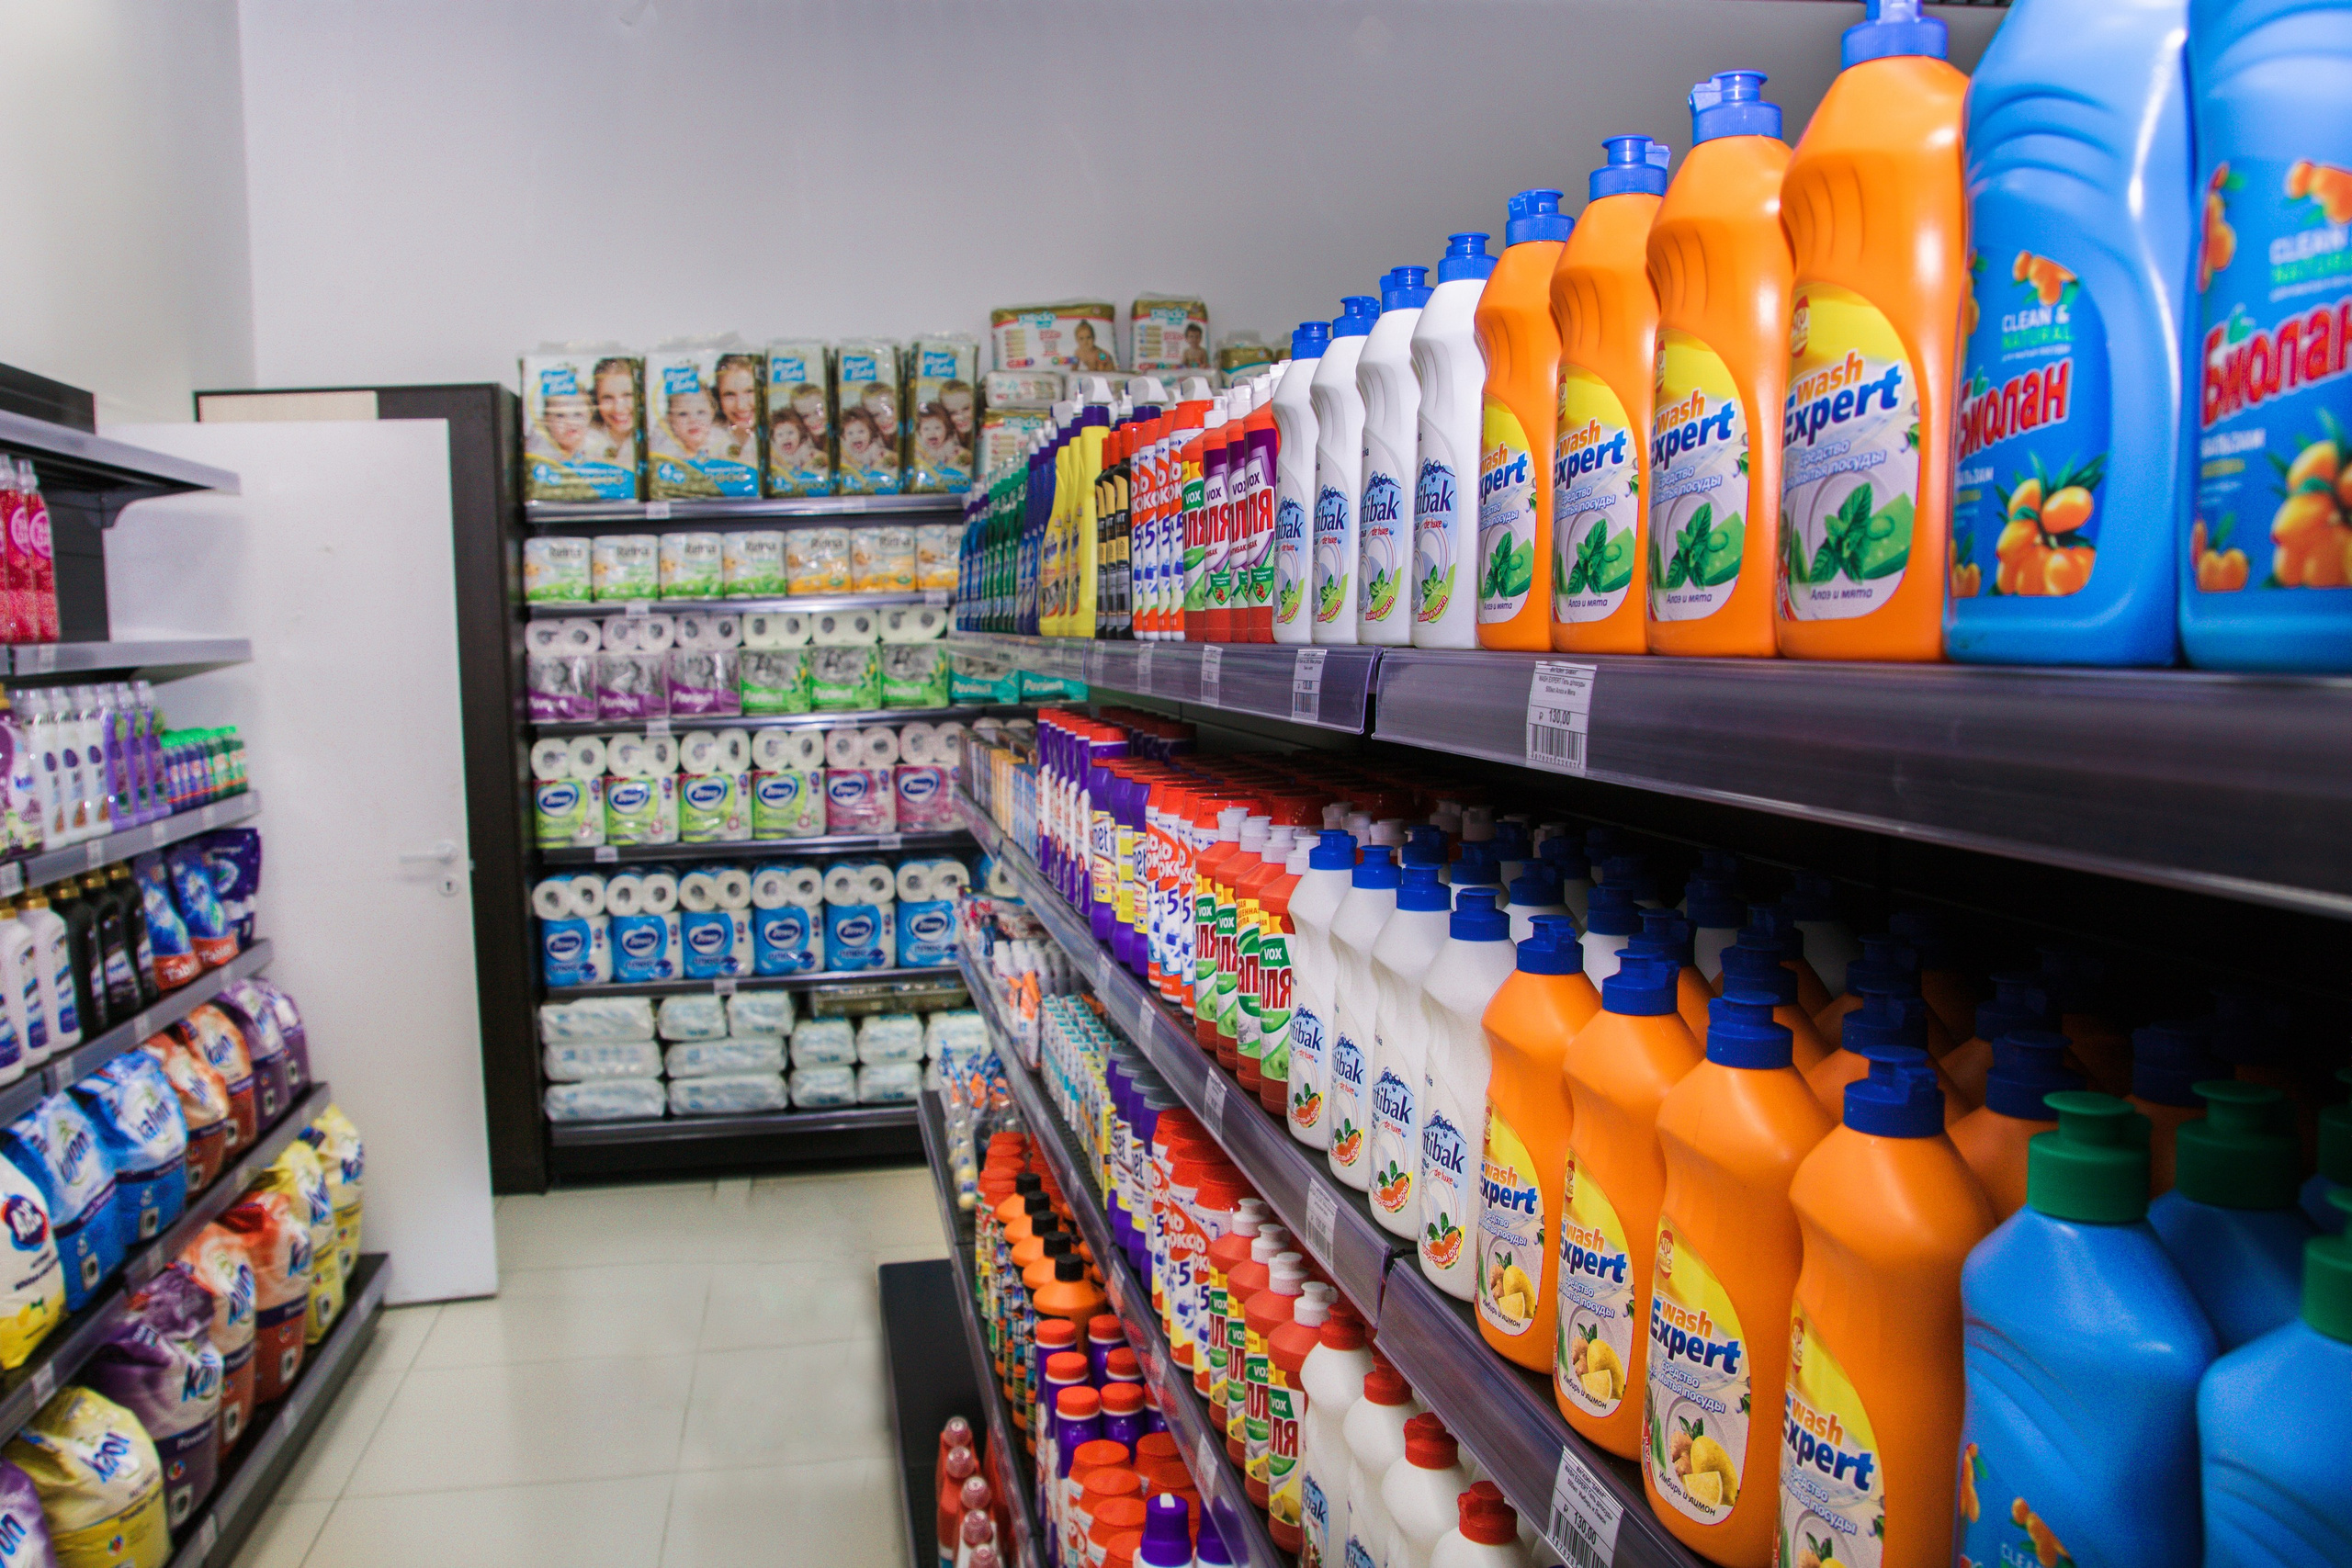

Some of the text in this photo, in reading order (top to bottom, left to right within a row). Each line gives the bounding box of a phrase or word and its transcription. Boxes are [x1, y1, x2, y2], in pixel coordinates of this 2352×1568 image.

[2002, 308, 2052, 333] CLEAN
[1797, 352, 1863, 405] wash
[1657, 389, 1705, 434] wash
[1559, 419, 1600, 458] wash
[1651, 400, 1735, 470] xpert
[1206, 486, 1221, 502] VOX
[1145, 520, 1155, 550] 5
[1549, 709, 1571, 726] 130,00
[1167, 889, 1178, 916] 5
[1182, 897, 1190, 923] 5
[1198, 906, 1212, 917] VOX
[1218, 917, 1235, 928] VOX
[1263, 947, 1283, 961] VOX
[1441, 1169, 1453, 1185] luxe
[1485, 1162, 1517, 1188] wash
[1498, 1228, 1527, 1247] посуды
[1566, 1223, 1604, 1253] wash
[1179, 1261, 1191, 1286] 5
[1200, 1285, 1210, 1311] 5
[1581, 1297, 1615, 1318] посуды
[1662, 1300, 1713, 1338] wash
[1650, 1296, 1741, 1374] Expert
[1662, 1360, 1699, 1388] средство
[1271, 1396, 1286, 1412] VOX
[1684, 1388, 1725, 1415] посуды
[1792, 1397, 1843, 1447] wash
[1574, 1474, 1589, 1493] EXPERT
[1574, 1512, 1597, 1545] 130,00
[1813, 1502, 1858, 1536] посуды
